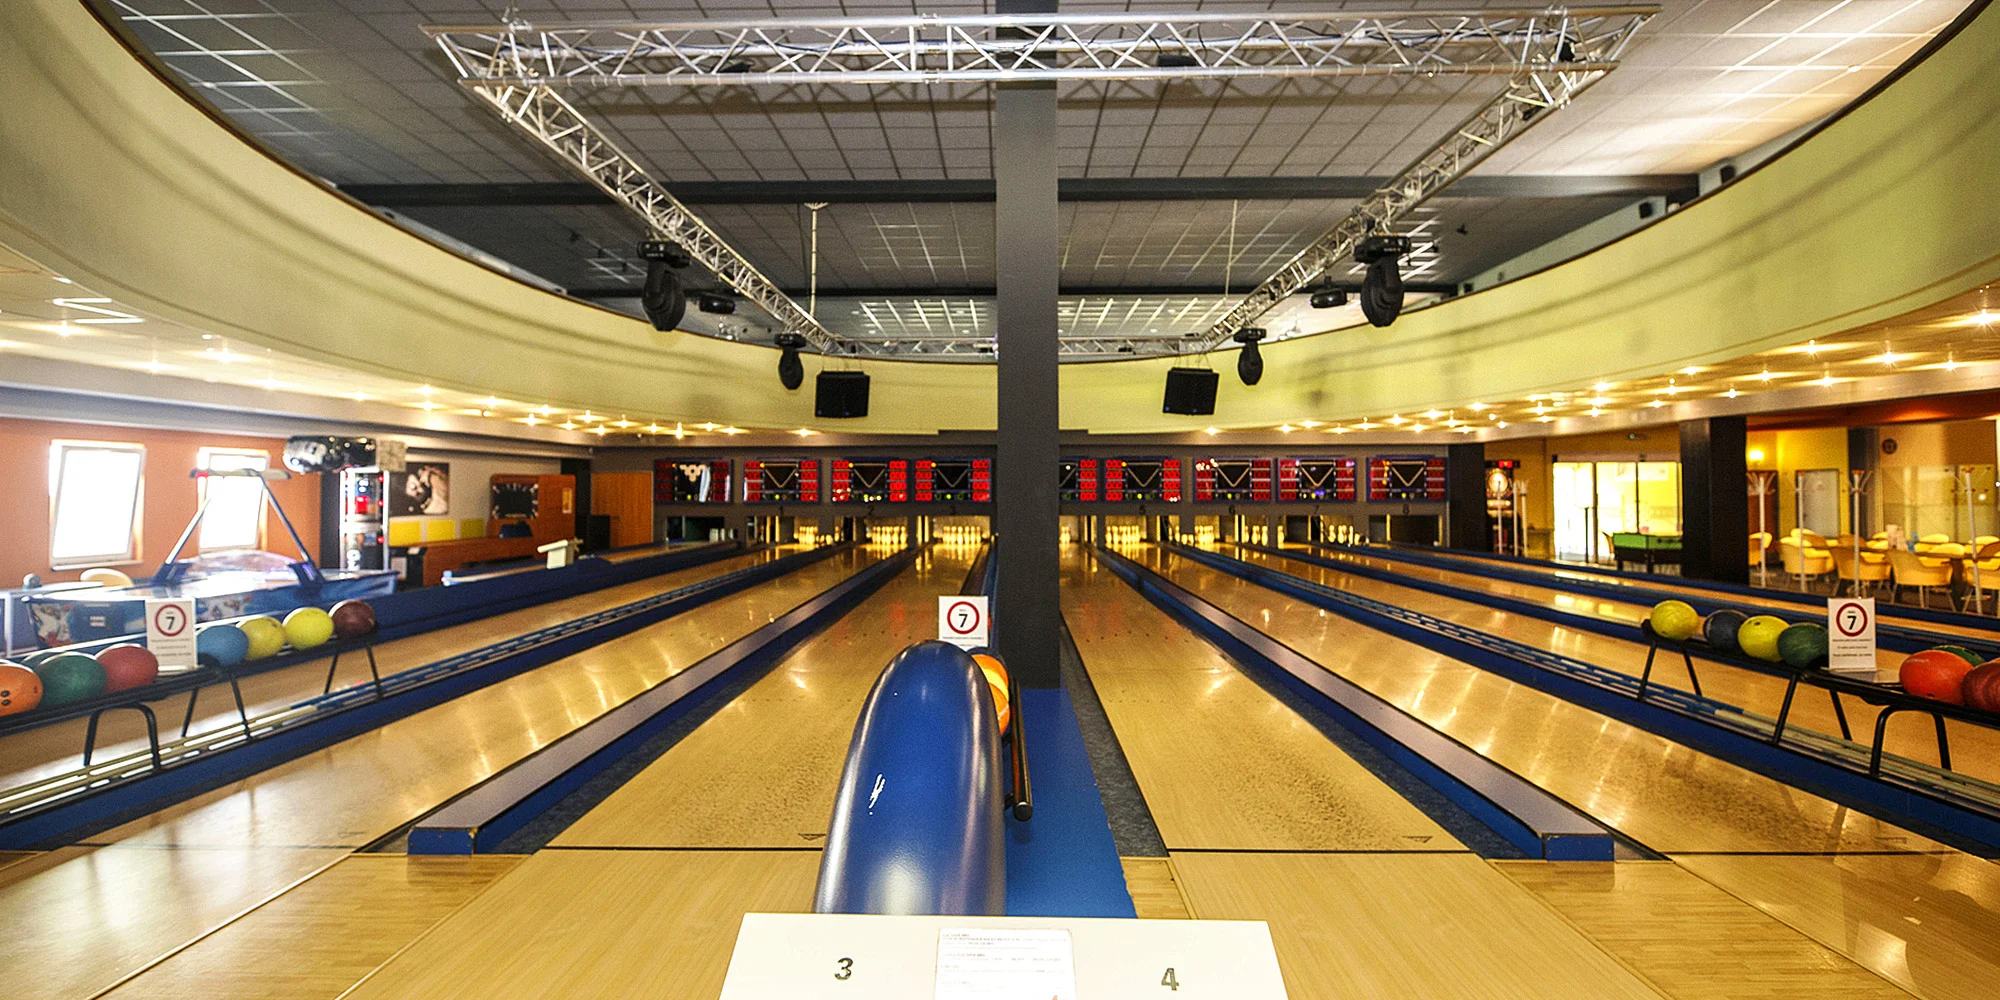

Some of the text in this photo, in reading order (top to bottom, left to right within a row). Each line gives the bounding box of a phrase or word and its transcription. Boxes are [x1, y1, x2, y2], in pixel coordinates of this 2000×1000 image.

[165, 615, 175, 630] 7
[958, 613, 968, 628] 7
[1847, 615, 1857, 630] 7
[834, 957, 854, 981] 3
[1161, 967, 1180, 991] 4
